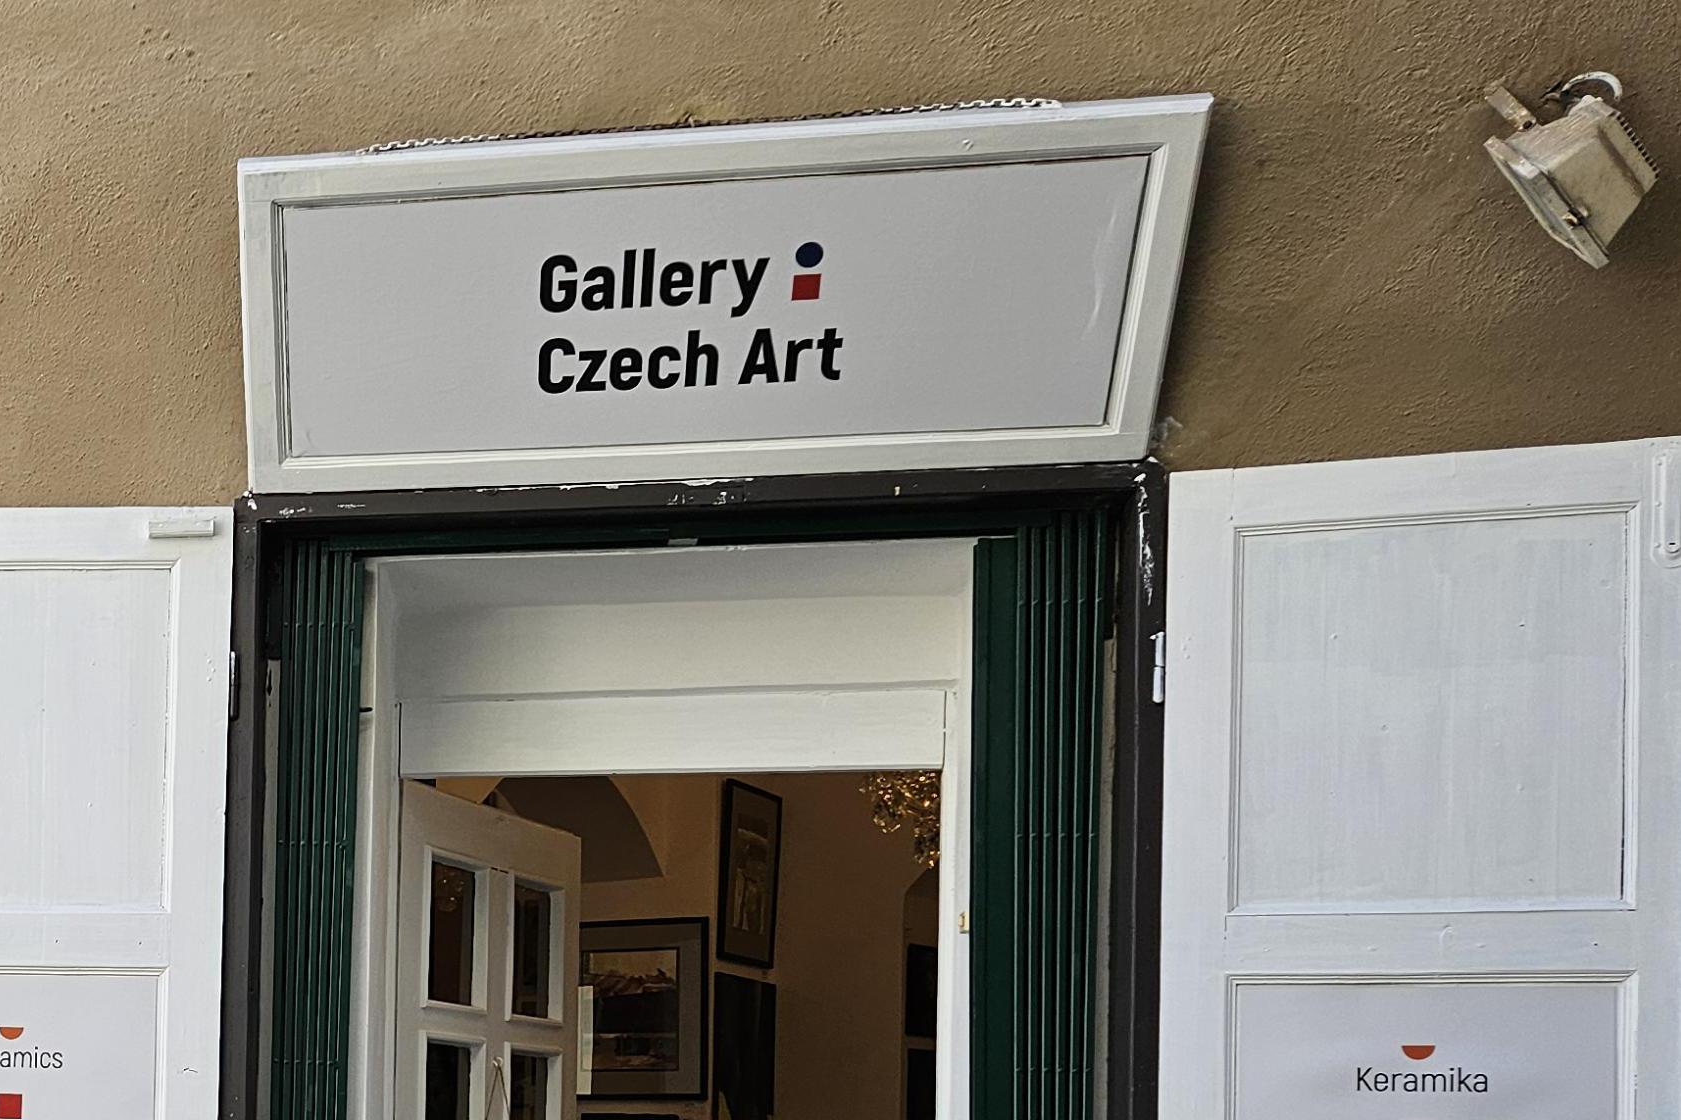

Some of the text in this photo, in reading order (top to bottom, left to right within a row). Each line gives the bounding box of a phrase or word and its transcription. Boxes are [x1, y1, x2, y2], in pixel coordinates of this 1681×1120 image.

[540, 248, 770, 317] Gallery
[538, 328, 843, 394] Czech Art
[1357, 1068, 1487, 1092] Keramika
